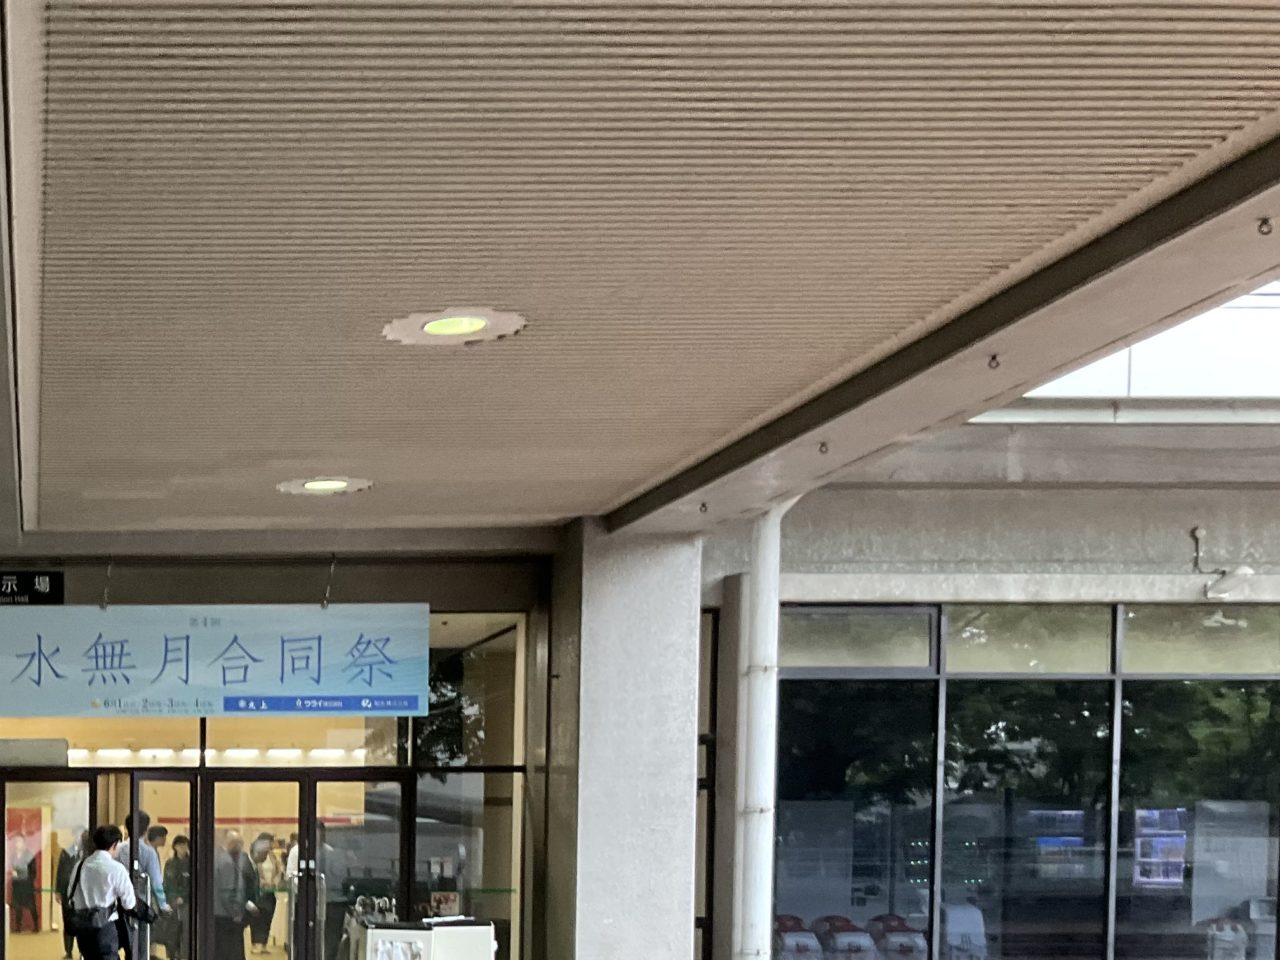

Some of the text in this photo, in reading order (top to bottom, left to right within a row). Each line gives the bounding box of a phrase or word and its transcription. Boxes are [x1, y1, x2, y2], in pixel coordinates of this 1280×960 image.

[11, 631, 399, 688] 水無月合同祭
